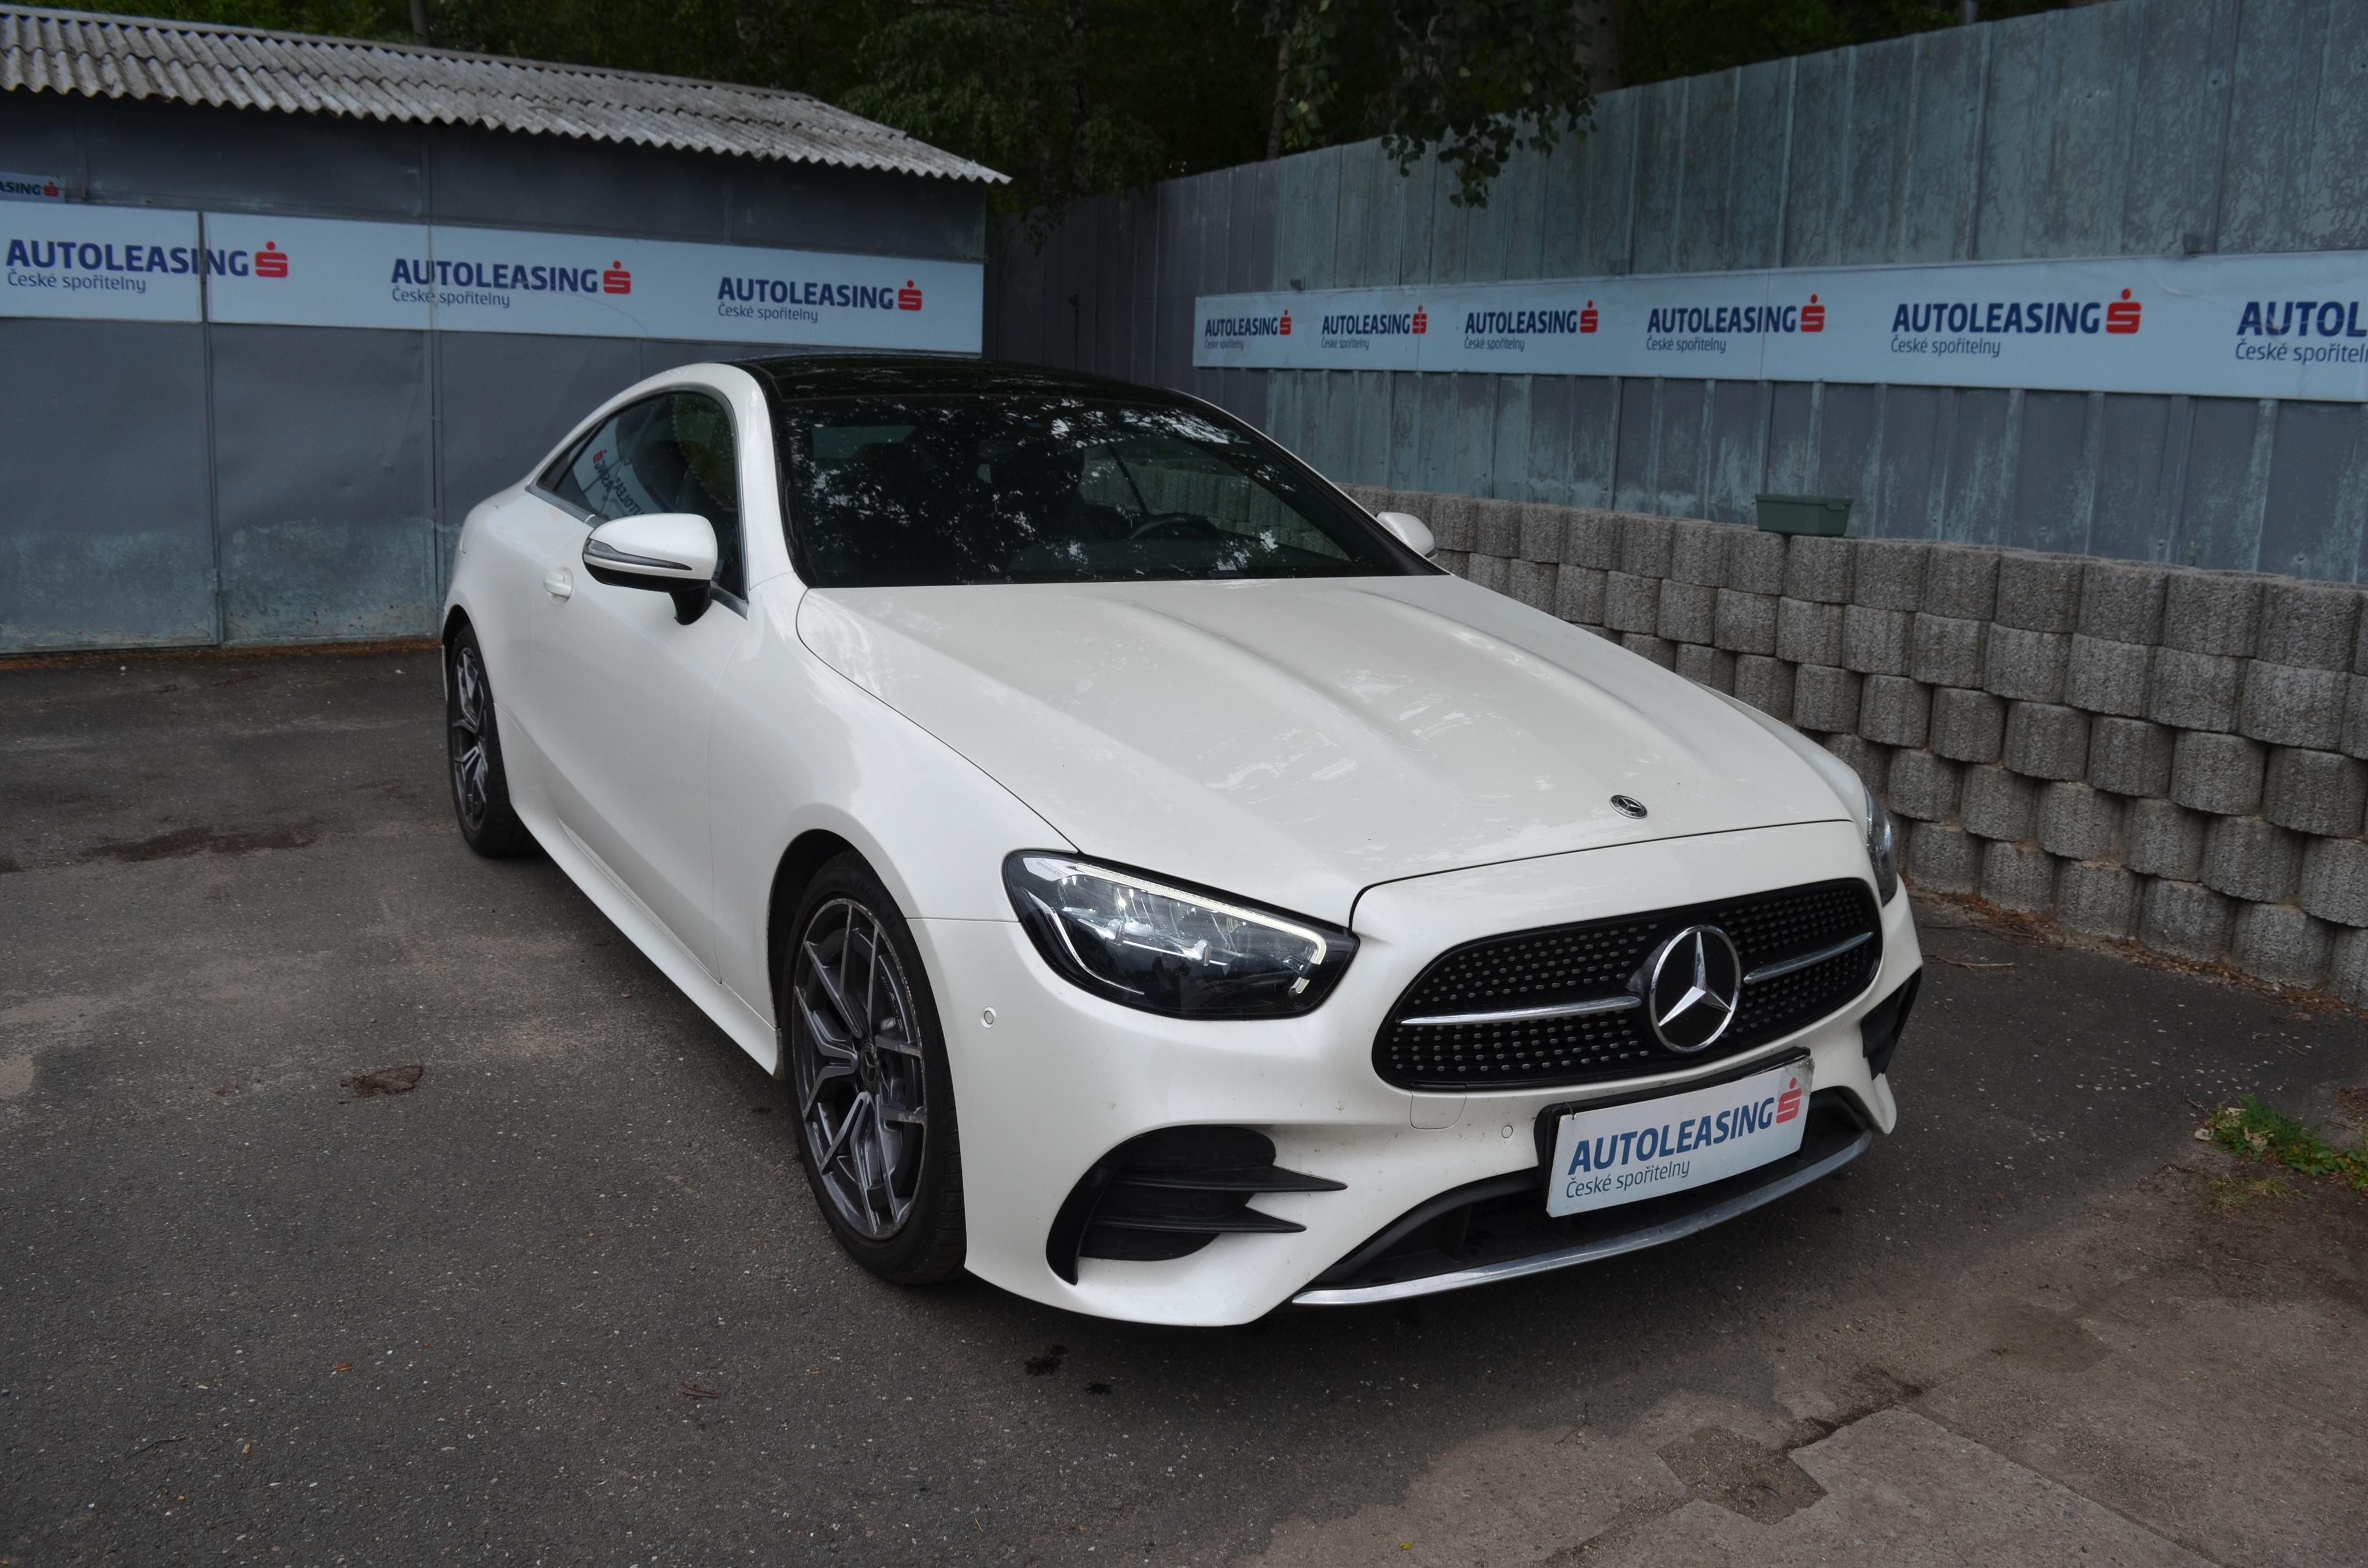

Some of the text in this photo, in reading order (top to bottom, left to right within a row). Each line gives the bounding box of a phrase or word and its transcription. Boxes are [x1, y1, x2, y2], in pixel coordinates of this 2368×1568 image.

[6, 239, 248, 276] AUTOLEASING
[8, 269, 146, 294] České spořitelny
[391, 259, 597, 292] AUTOLEASING
[439, 291, 510, 308] spořitelny
[718, 277, 893, 309] AUTOLEASING
[719, 302, 817, 323] České spořitelny
[1322, 314, 1410, 335] AUTOLEASING
[1465, 310, 1577, 333] AUTOLEASING
[1647, 306, 1796, 333] AUTOLEASING
[1892, 302, 2100, 333] AUTOLEASING
[2237, 302, 2367, 337] AUTOL
[1205, 317, 1278, 336] AUTOLEASING
[1464, 335, 1525, 352] České spořitelny
[1646, 335, 1726, 354] České spořitelny
[1891, 335, 2000, 358] České spořitelny
[2236, 339, 2287, 361] České
[1567, 1097, 1774, 1175] AUTOLEASING
[1566, 1160, 1690, 1198] České spořitelny
